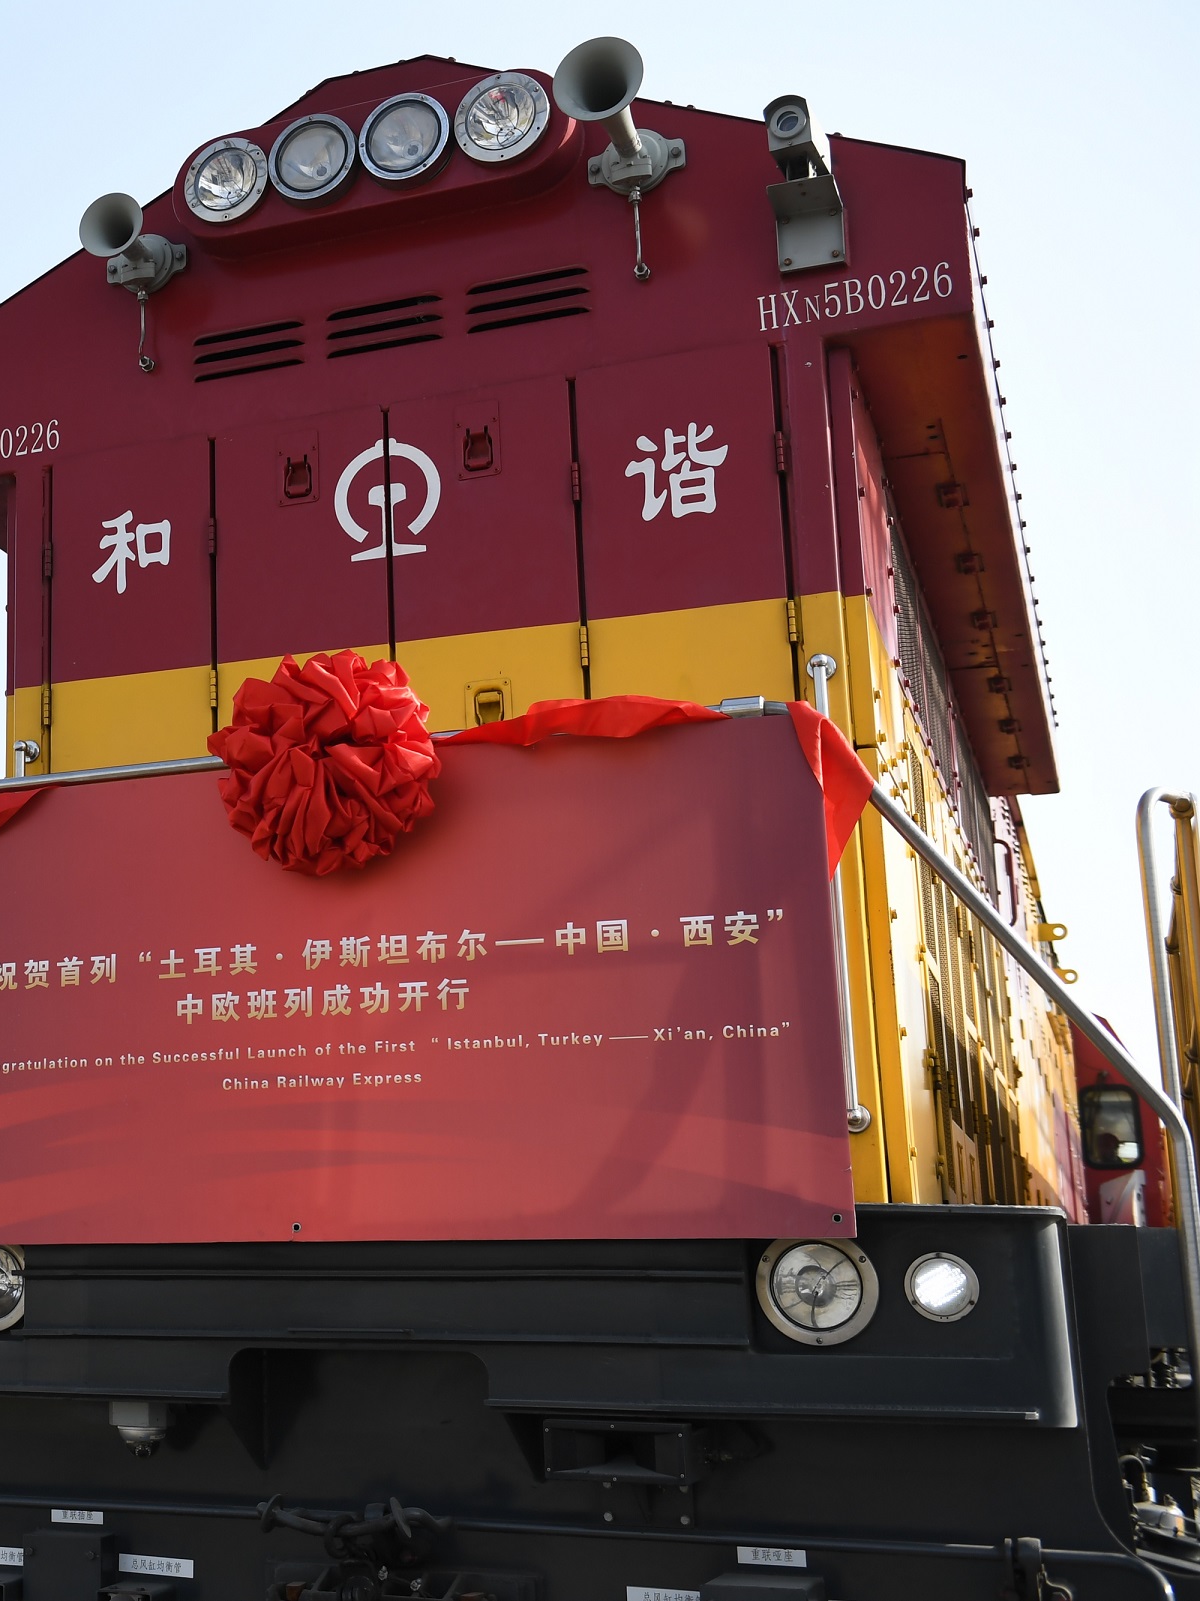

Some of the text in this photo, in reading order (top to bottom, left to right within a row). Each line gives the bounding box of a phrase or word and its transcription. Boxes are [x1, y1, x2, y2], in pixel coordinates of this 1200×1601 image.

[624, 422, 729, 522] 谐
[92, 509, 171, 594] 和
[176, 977, 470, 1025] 中欧班列成功开行
[95, 1056, 113, 1067] on
[119, 1052, 146, 1066] the
[152, 1047, 240, 1064] Successful
[247, 1043, 308, 1060] Launch
[315, 1042, 332, 1056] of
[338, 1041, 367, 1055] the
[374, 1038, 416, 1054] First
[222, 1069, 423, 1091] China Railway Express
